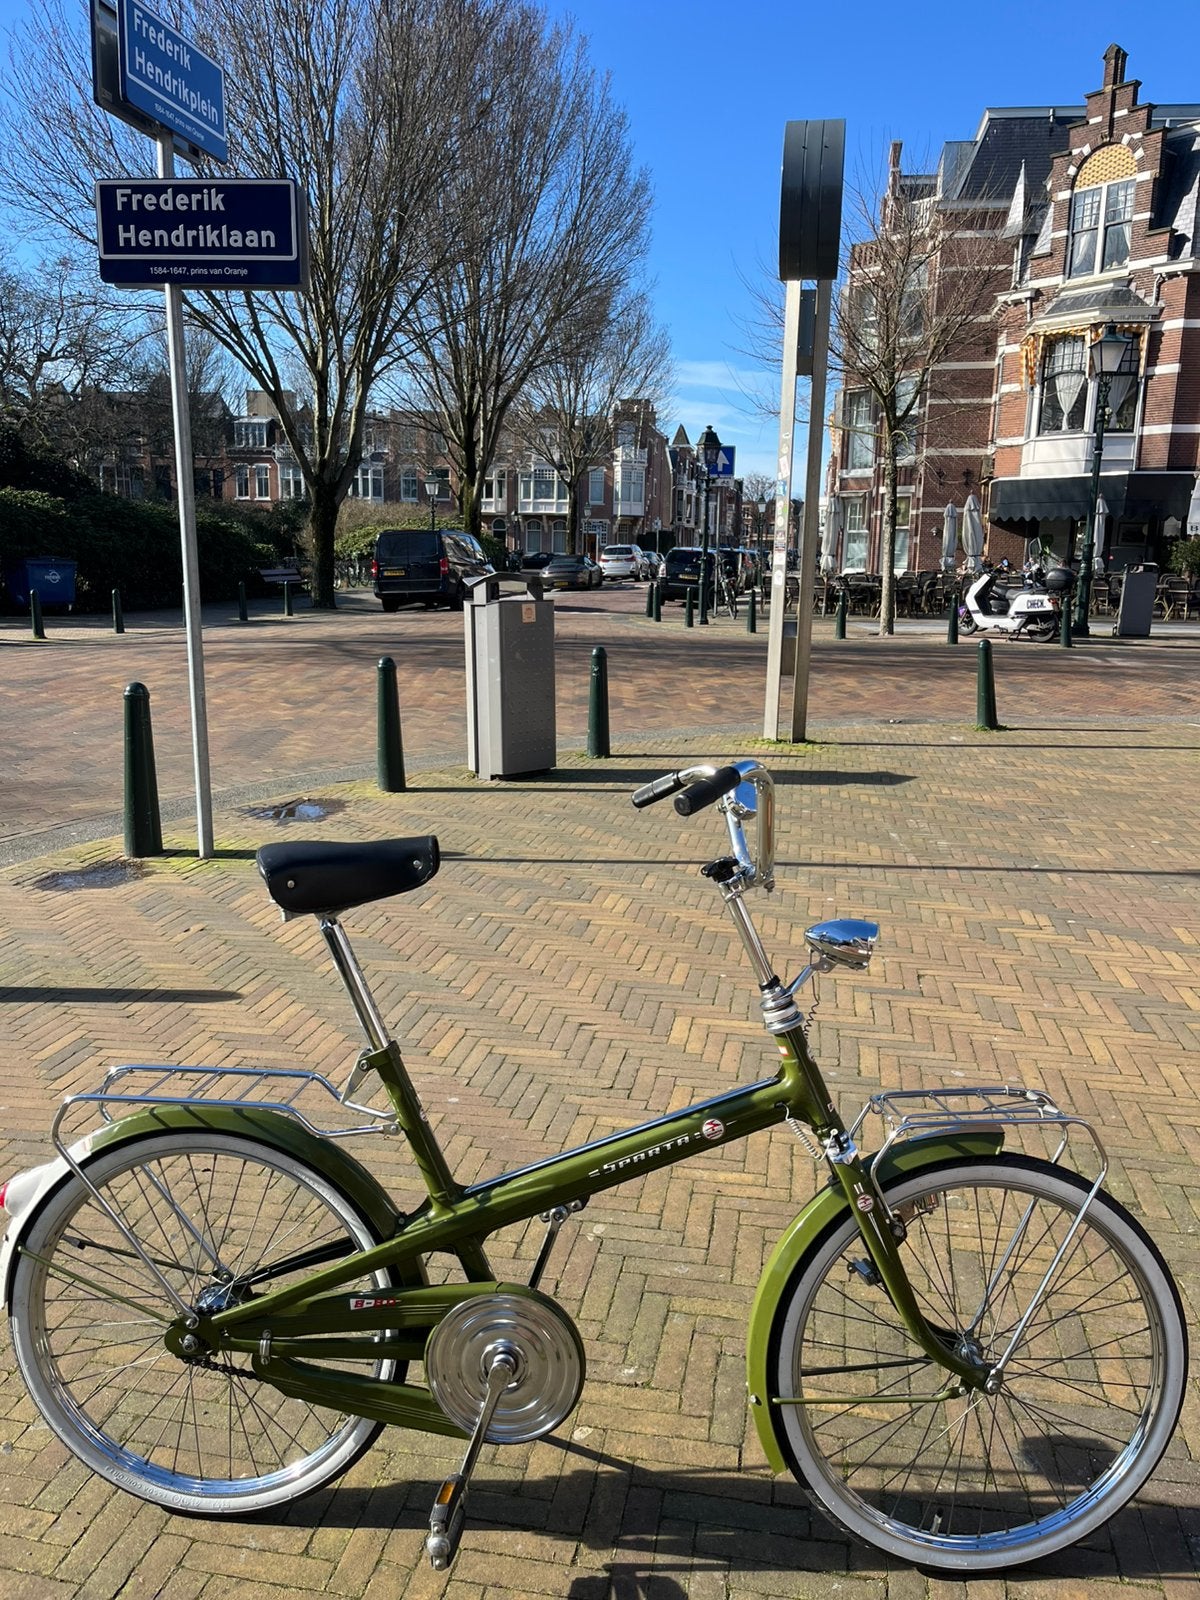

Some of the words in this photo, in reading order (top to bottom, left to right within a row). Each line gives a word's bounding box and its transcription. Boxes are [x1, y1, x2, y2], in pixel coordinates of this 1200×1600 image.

[133, 8, 192, 72] Frederik
[134, 46, 219, 125] Hendrikplein
[115, 188, 226, 211] Frederik
[117, 224, 276, 248] Hendriklaan
[149, 266, 189, 276] 1584-1647,
[190, 266, 208, 276] prins
[223, 266, 249, 277] Oranje
[602, 1134, 690, 1175] SPARTA
